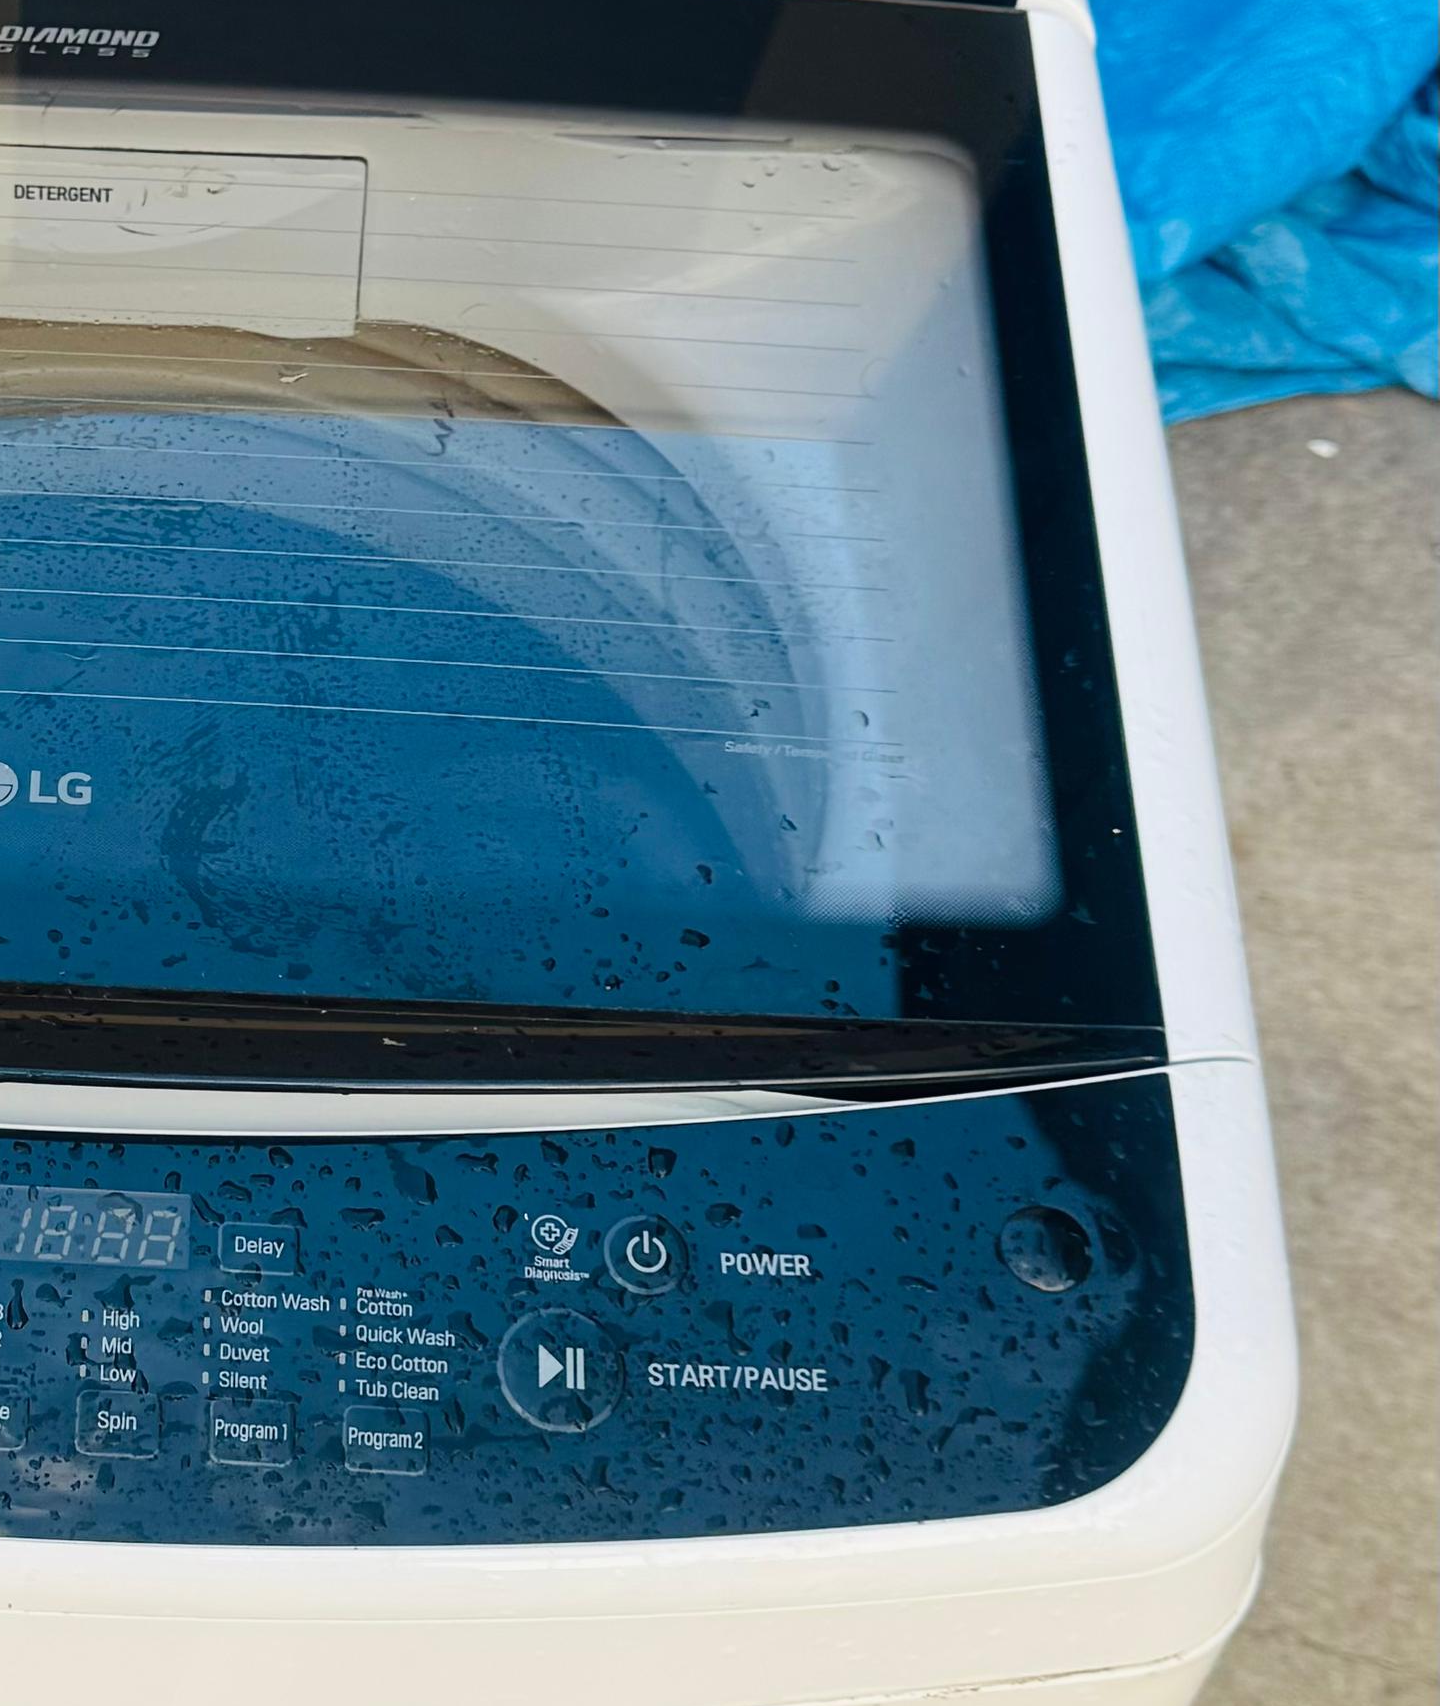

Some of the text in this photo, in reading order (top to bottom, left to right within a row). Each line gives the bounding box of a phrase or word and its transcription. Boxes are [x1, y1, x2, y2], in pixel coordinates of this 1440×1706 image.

[13, 184, 114, 204] DETERGENT
[29, 770, 93, 806] LG
[234, 1236, 285, 1259] Delay
[534, 1255, 570, 1269] Smart
[720, 1251, 812, 1277] POWER
[221, 1289, 330, 1312] Cotton Wash
[356, 1297, 413, 1317] Cotton
[102, 1309, 141, 1331] High
[221, 1316, 264, 1335] Wool
[101, 1336, 132, 1355] Mid
[355, 1324, 456, 1347] Quick Wash
[219, 1343, 270, 1363] Duvet
[355, 1352, 448, 1374] Eco Cotton
[100, 1364, 137, 1383] Low
[218, 1371, 268, 1390] Silent
[648, 1363, 828, 1392] START/PAUSE
[356, 1379, 440, 1401] Tub Clean
[97, 1410, 137, 1433] Spin
[214, 1418, 288, 1441] Program 1
[348, 1426, 424, 1450] Program 2
